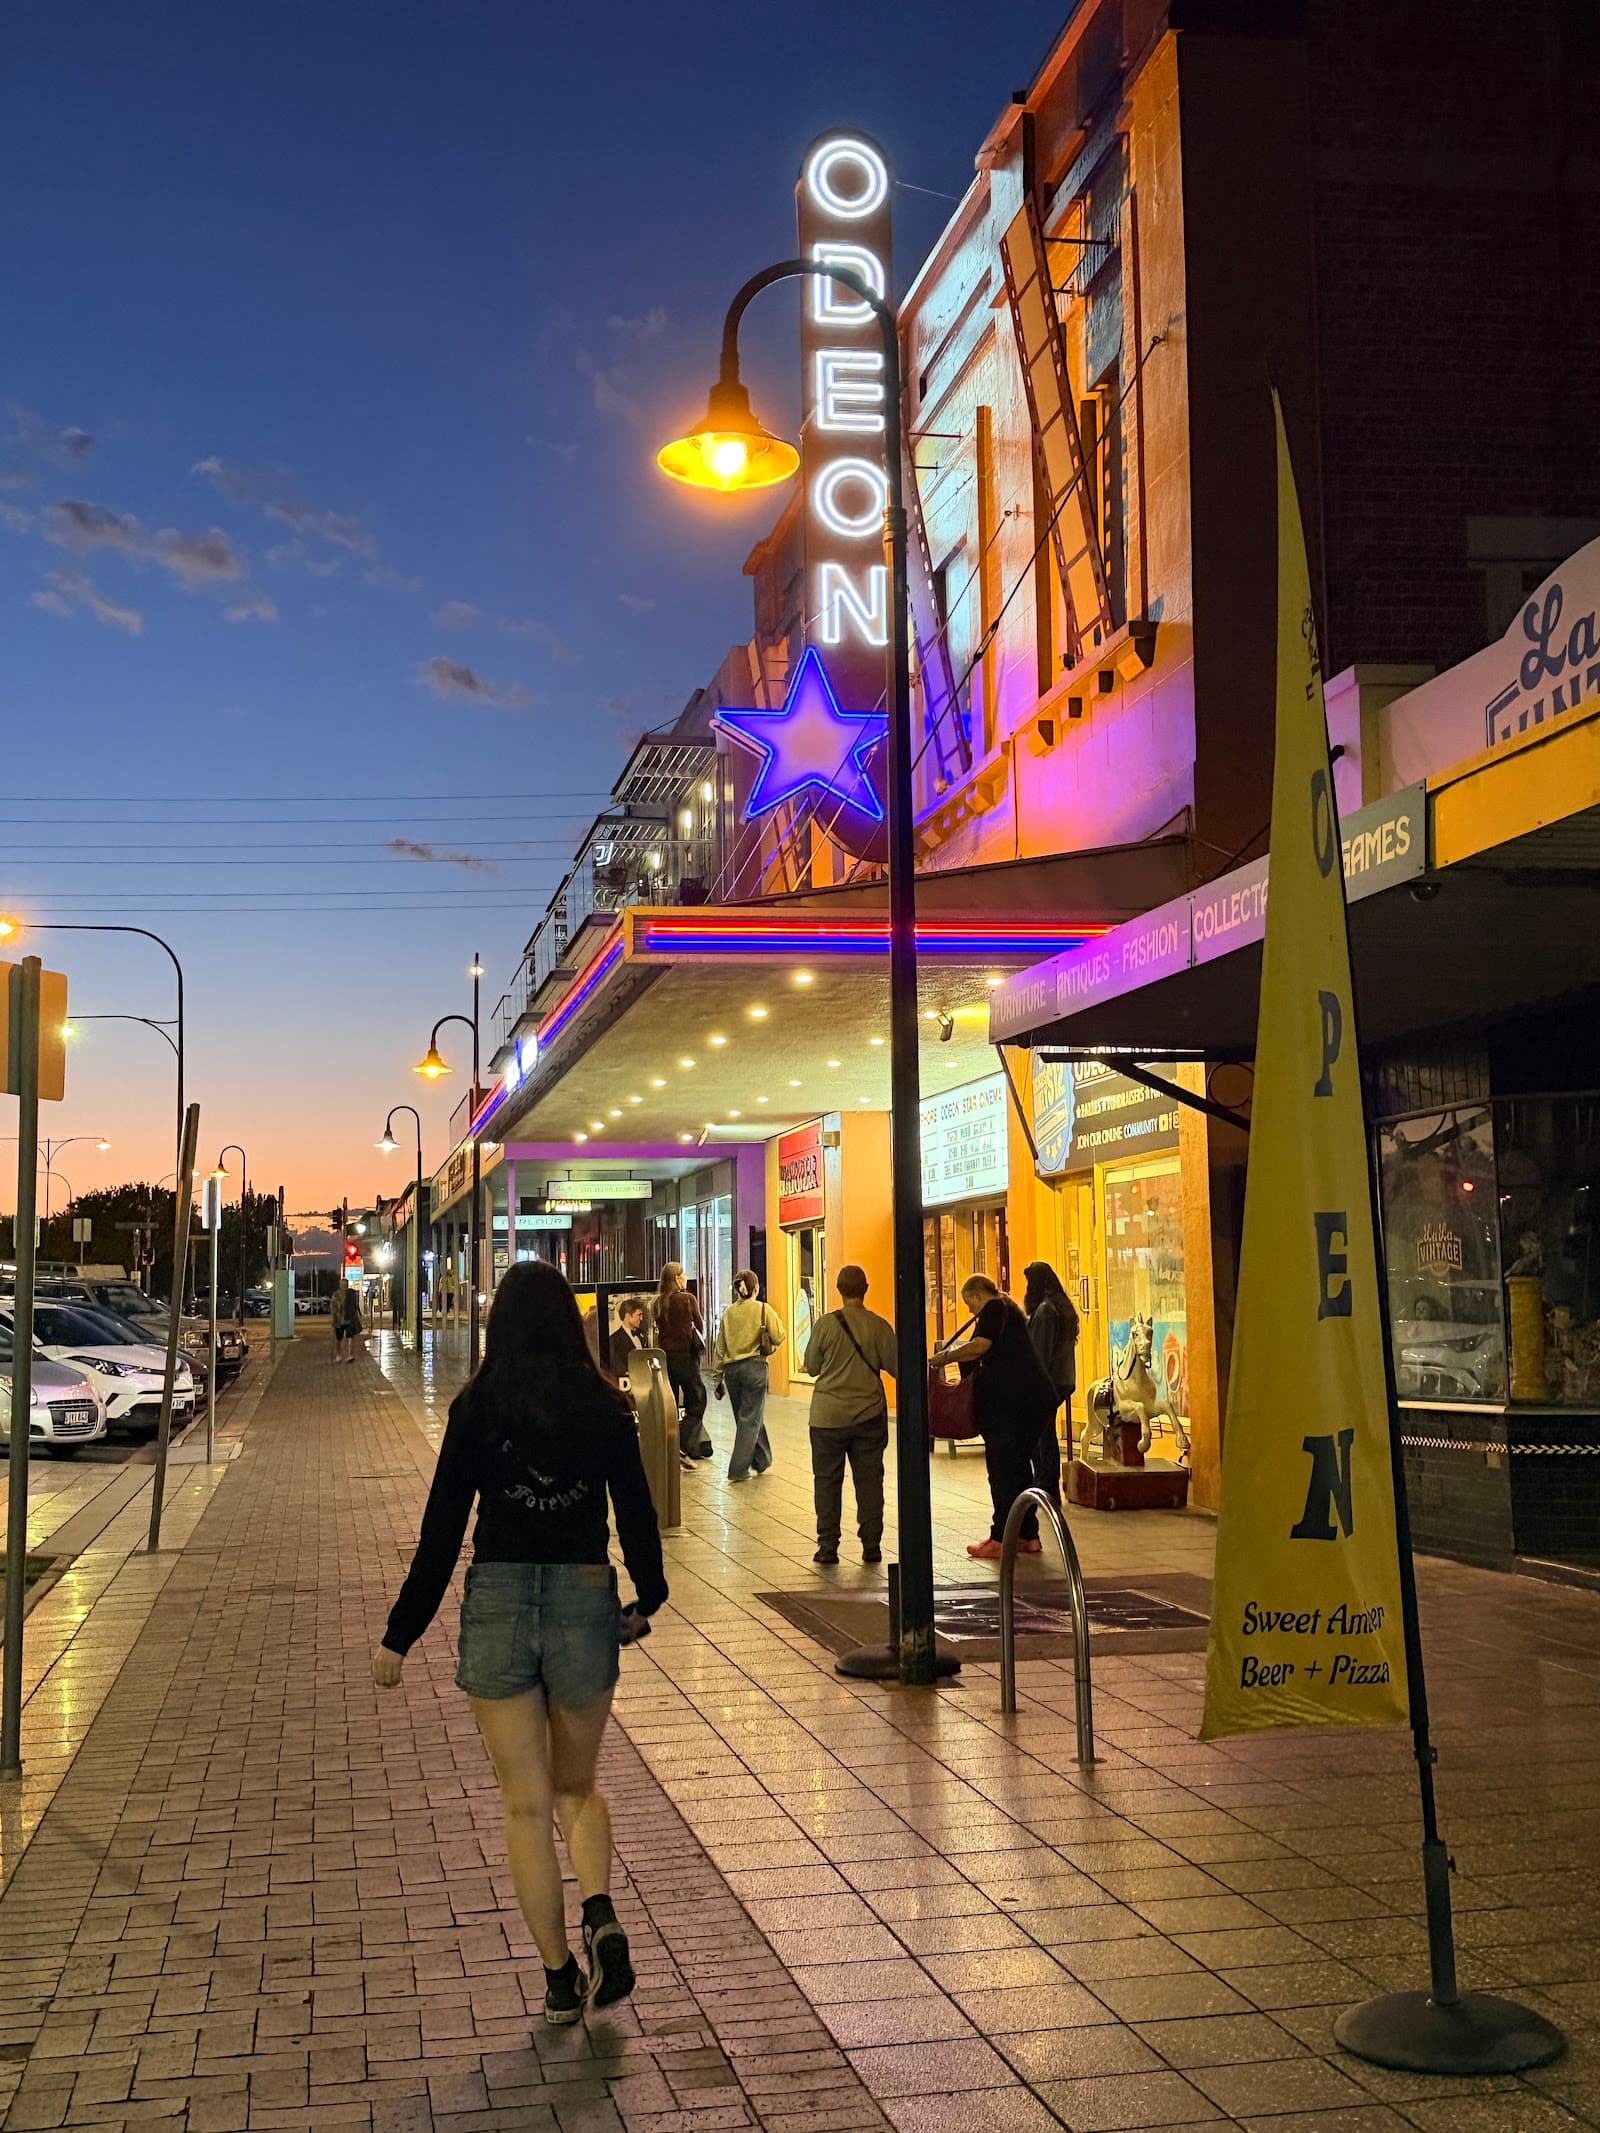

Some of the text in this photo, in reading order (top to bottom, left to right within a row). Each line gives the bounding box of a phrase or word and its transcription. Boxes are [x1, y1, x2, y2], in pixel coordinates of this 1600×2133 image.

[806, 138, 889, 646] ODEON
[992, 980, 1047, 1025] FURNITURE
[1056, 954, 1110, 1001] ANTIQUES
[1122, 919, 1179, 974] FASHION
[1193, 879, 1269, 943] COLLECTA
[1341, 814, 1411, 879] GAMES
[1102, 1126, 1124, 1143] ONLINE
[1123, 1118, 1159, 1139] COMMUNITY
[1289, 768, 1355, 1542] OPEN
[501, 1217, 563, 1227] PRLOUR
[1419, 1242, 1460, 1263] VINTAGE
[1242, 1601, 1322, 1636] Sweet
[1241, 1654, 1390, 1689] Beer + Pizza
